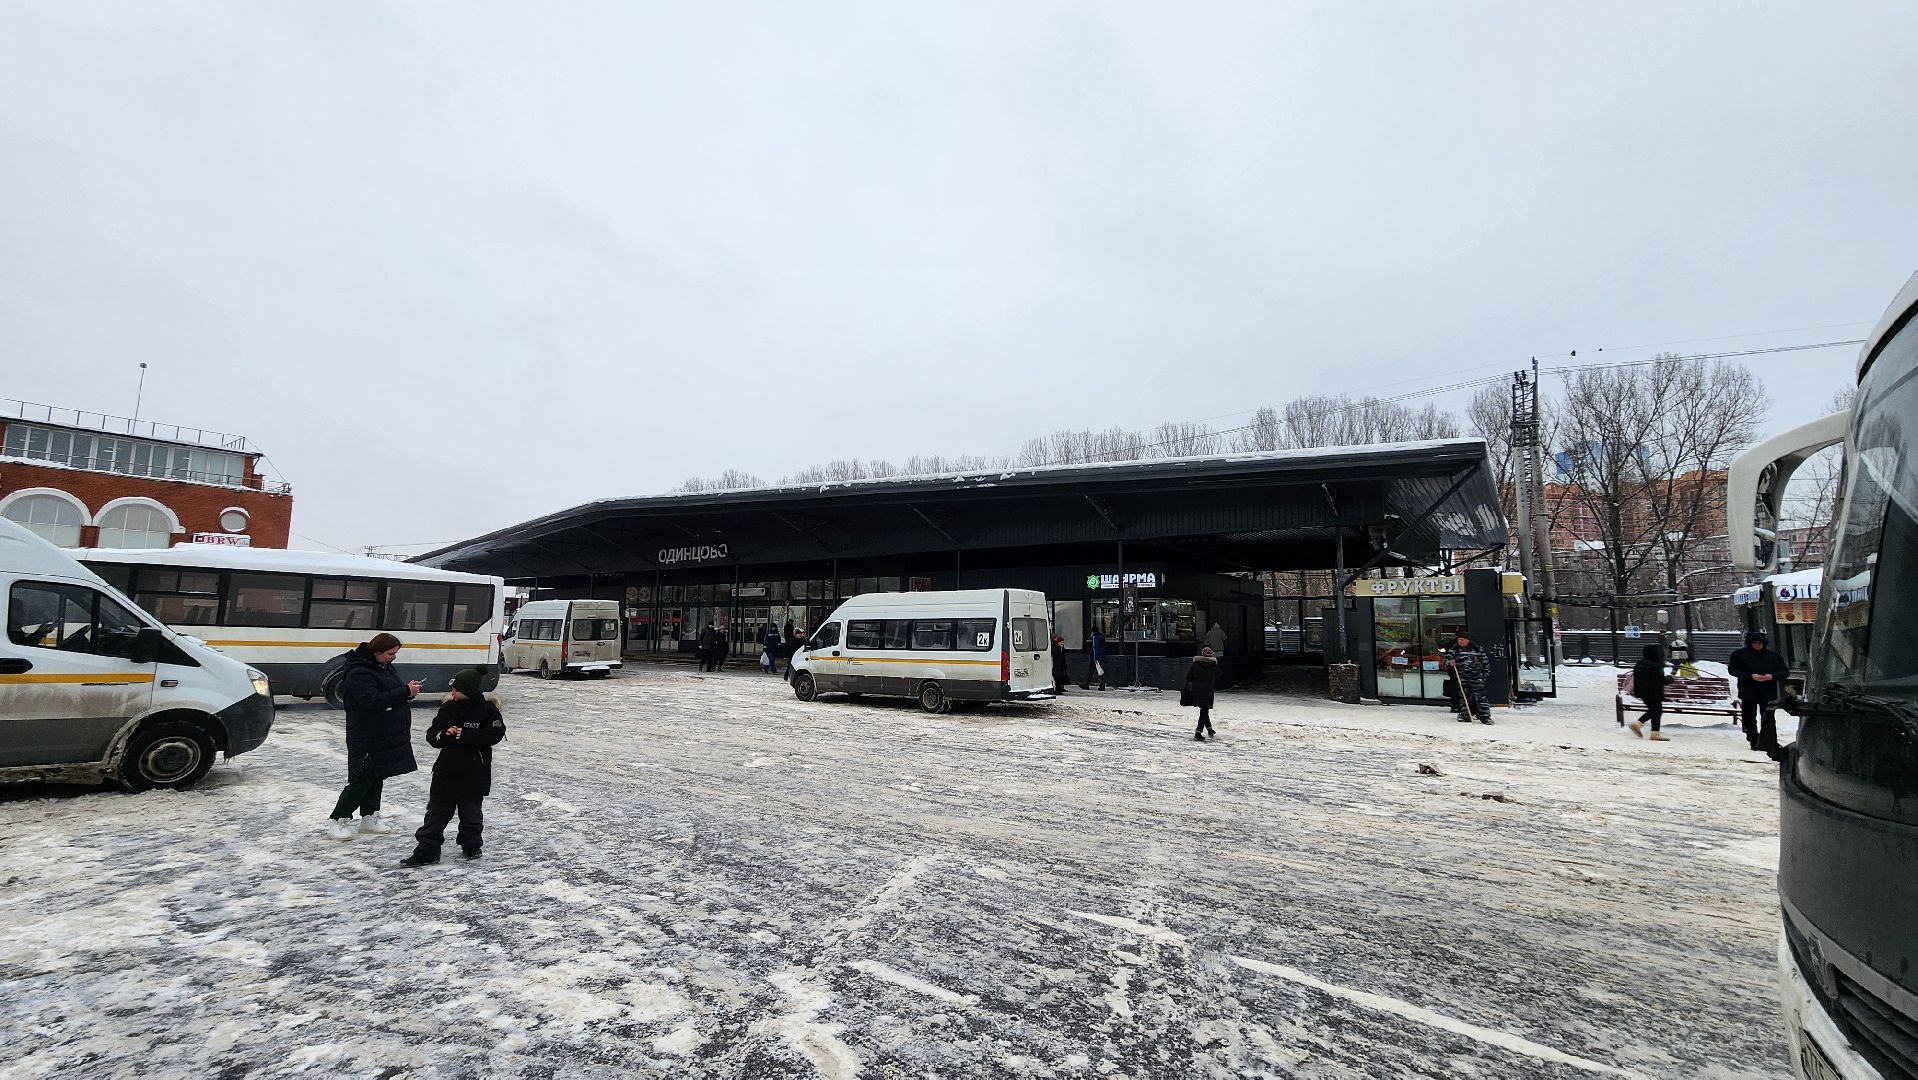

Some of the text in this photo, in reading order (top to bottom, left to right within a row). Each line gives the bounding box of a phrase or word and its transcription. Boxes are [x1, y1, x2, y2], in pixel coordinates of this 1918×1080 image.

[208, 536, 238, 545] BRW
[658, 543, 728, 565] ОДИНЦОВО
[1371, 577, 1460, 594] ФРУКТЫ
